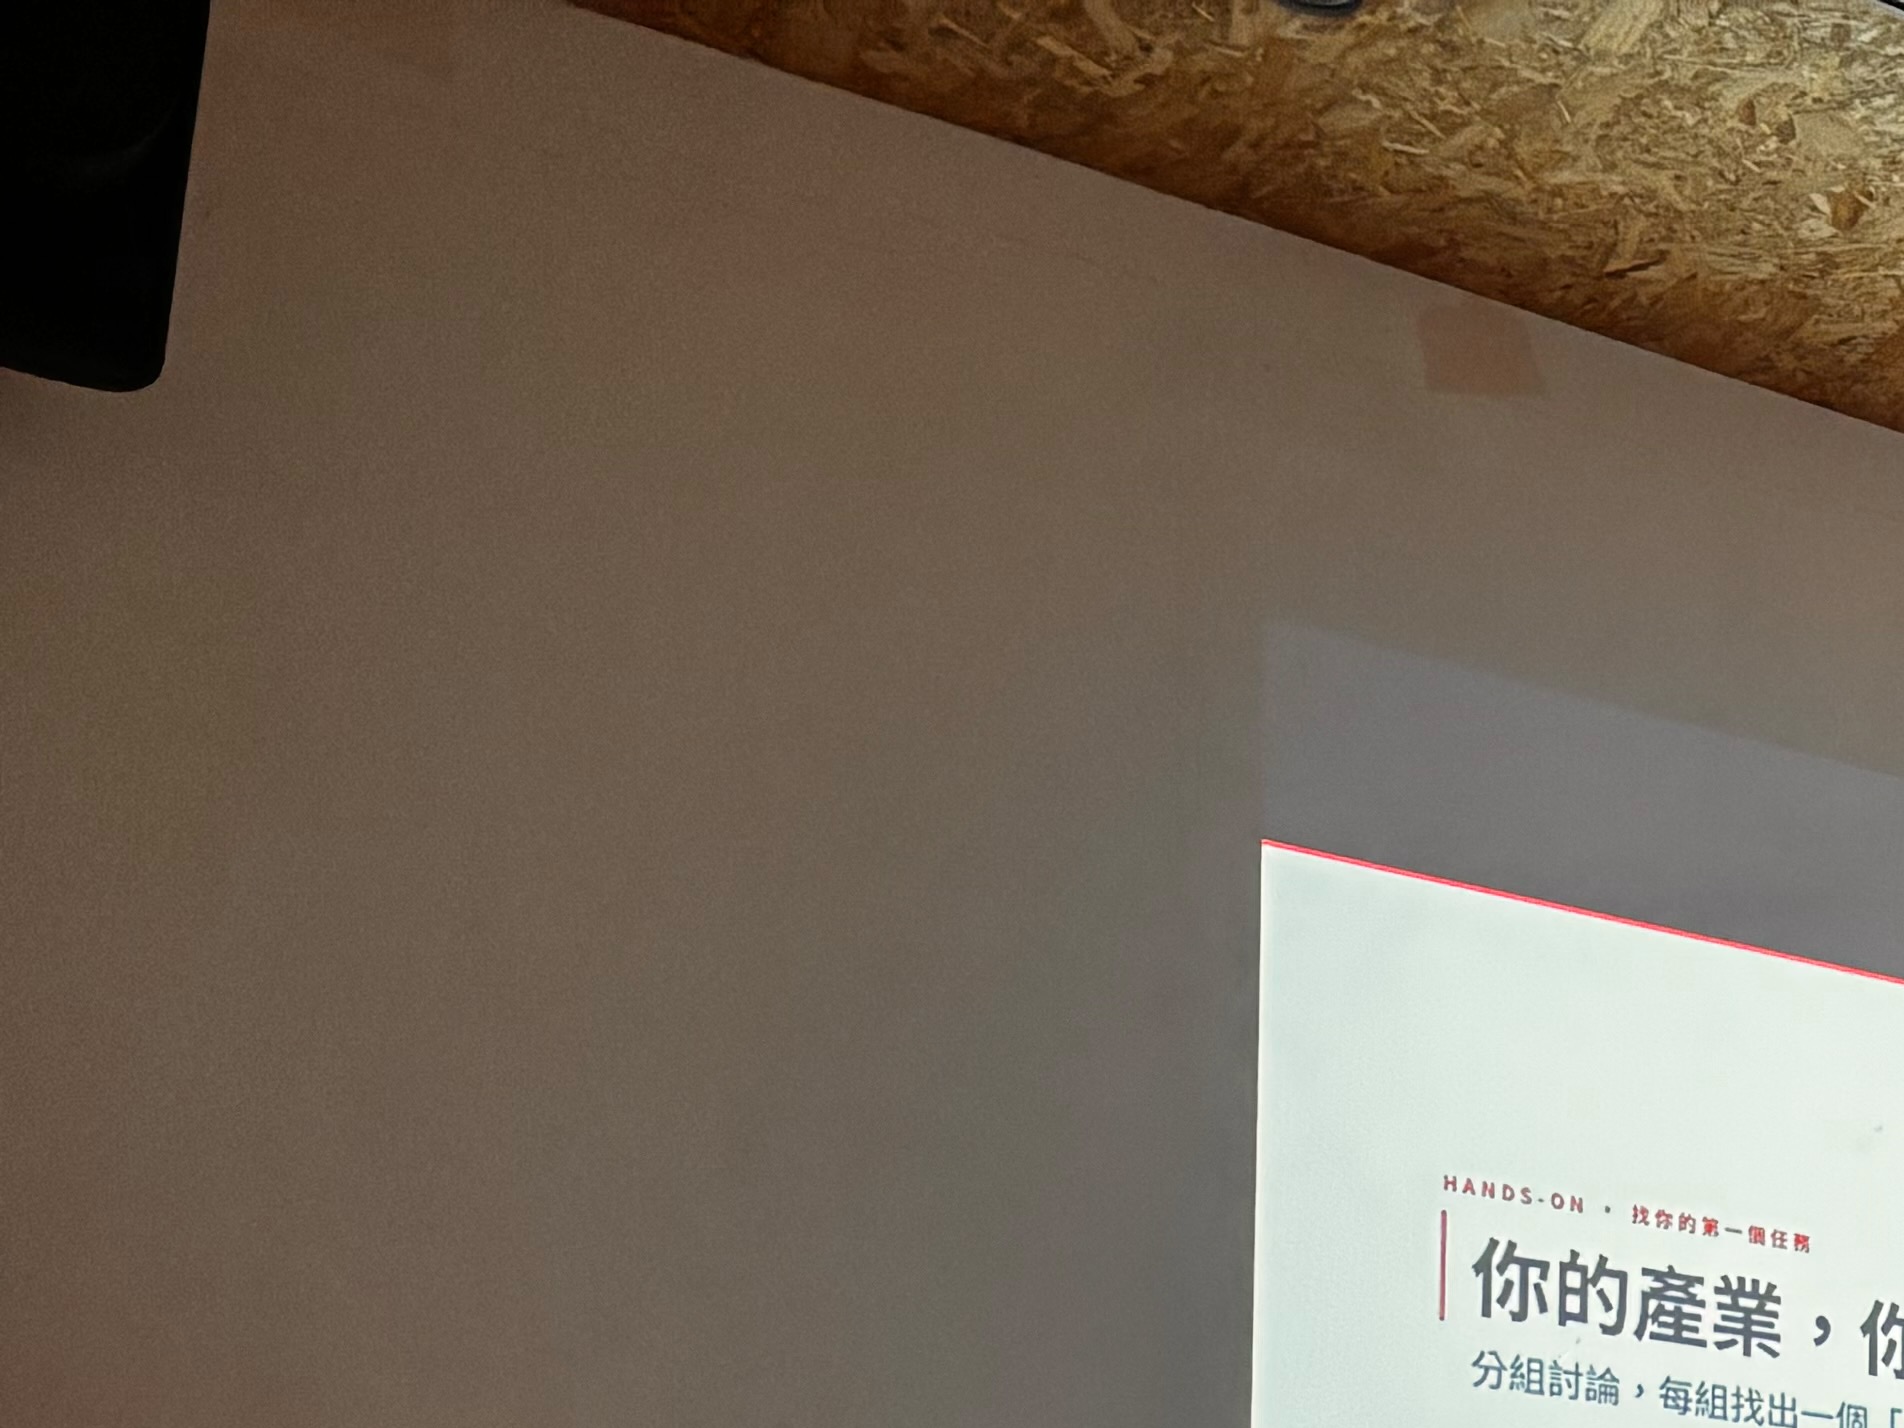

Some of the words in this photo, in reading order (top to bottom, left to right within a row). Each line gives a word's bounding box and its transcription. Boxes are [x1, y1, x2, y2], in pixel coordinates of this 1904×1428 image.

[1442, 1174, 1585, 1214] HANDS-ON
[1631, 1204, 1812, 1254] 找你的第一個任務
